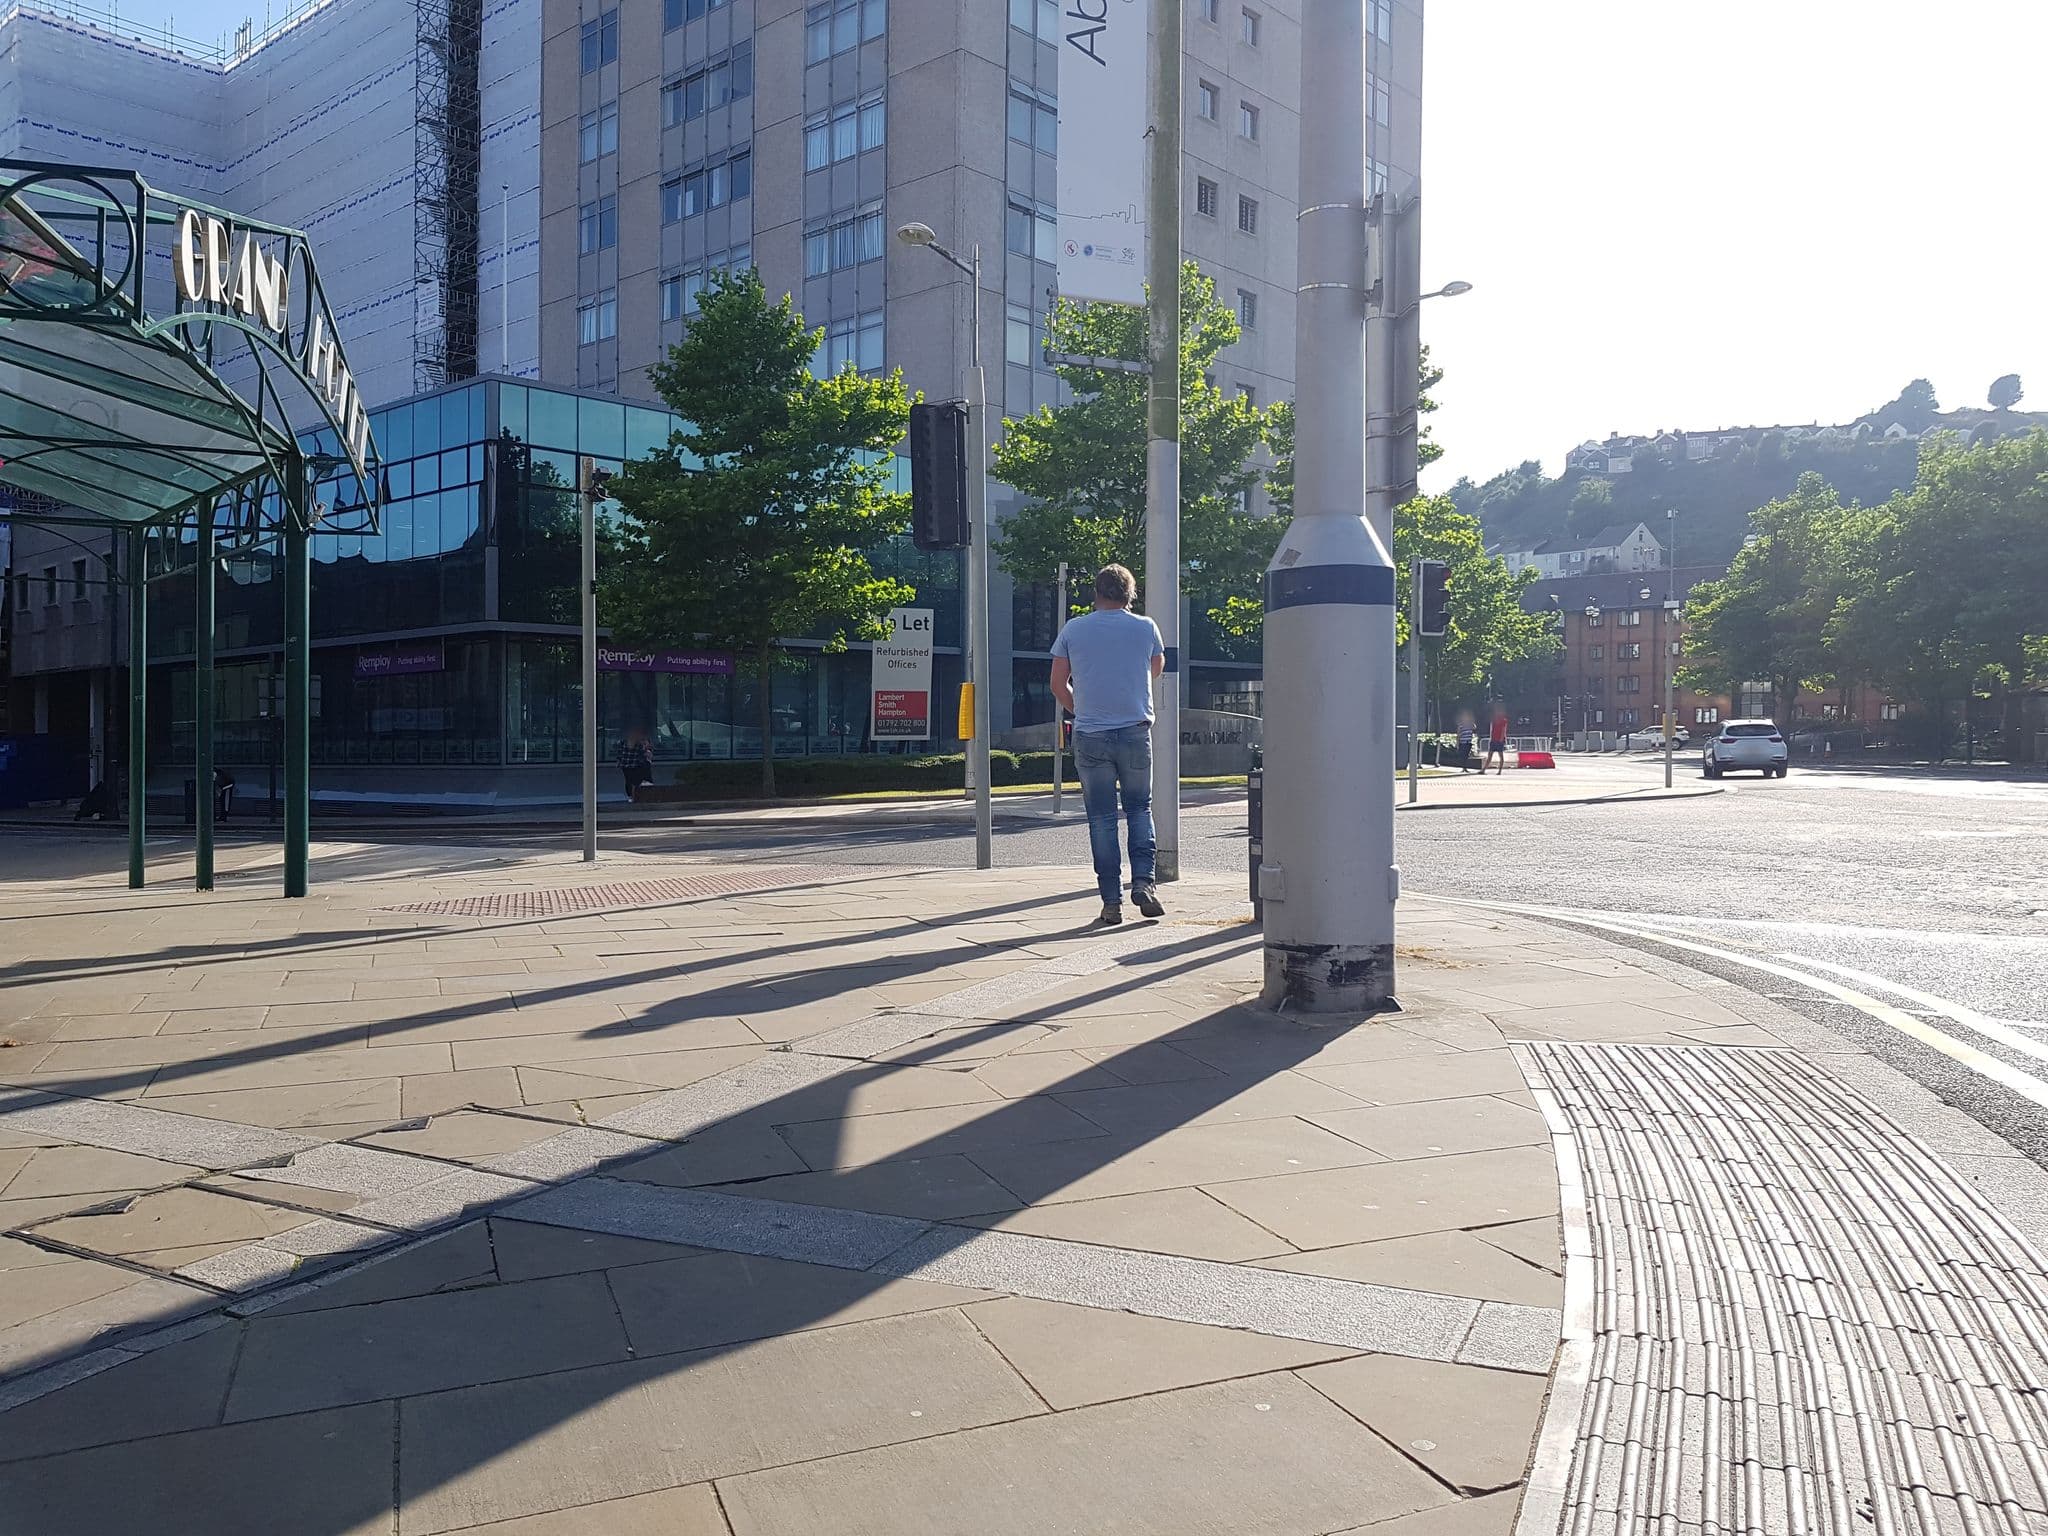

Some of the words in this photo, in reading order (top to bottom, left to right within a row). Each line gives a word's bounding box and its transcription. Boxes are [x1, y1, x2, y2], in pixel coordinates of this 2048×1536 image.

[177, 209, 288, 334] GRAND
[308, 314, 371, 479] HOTEL
[903, 615, 930, 631] Let
[877, 647, 929, 657] Refurbished
[359, 655, 391, 671] Remploy
[667, 656, 691, 666] Putting
[692, 658, 711, 667] ability
[713, 659, 727, 667] first
[888, 660, 917, 669] Offices
[878, 693, 905, 701] Lambert
[878, 701, 897, 709] Smith
[878, 709, 907, 717] Hampton
